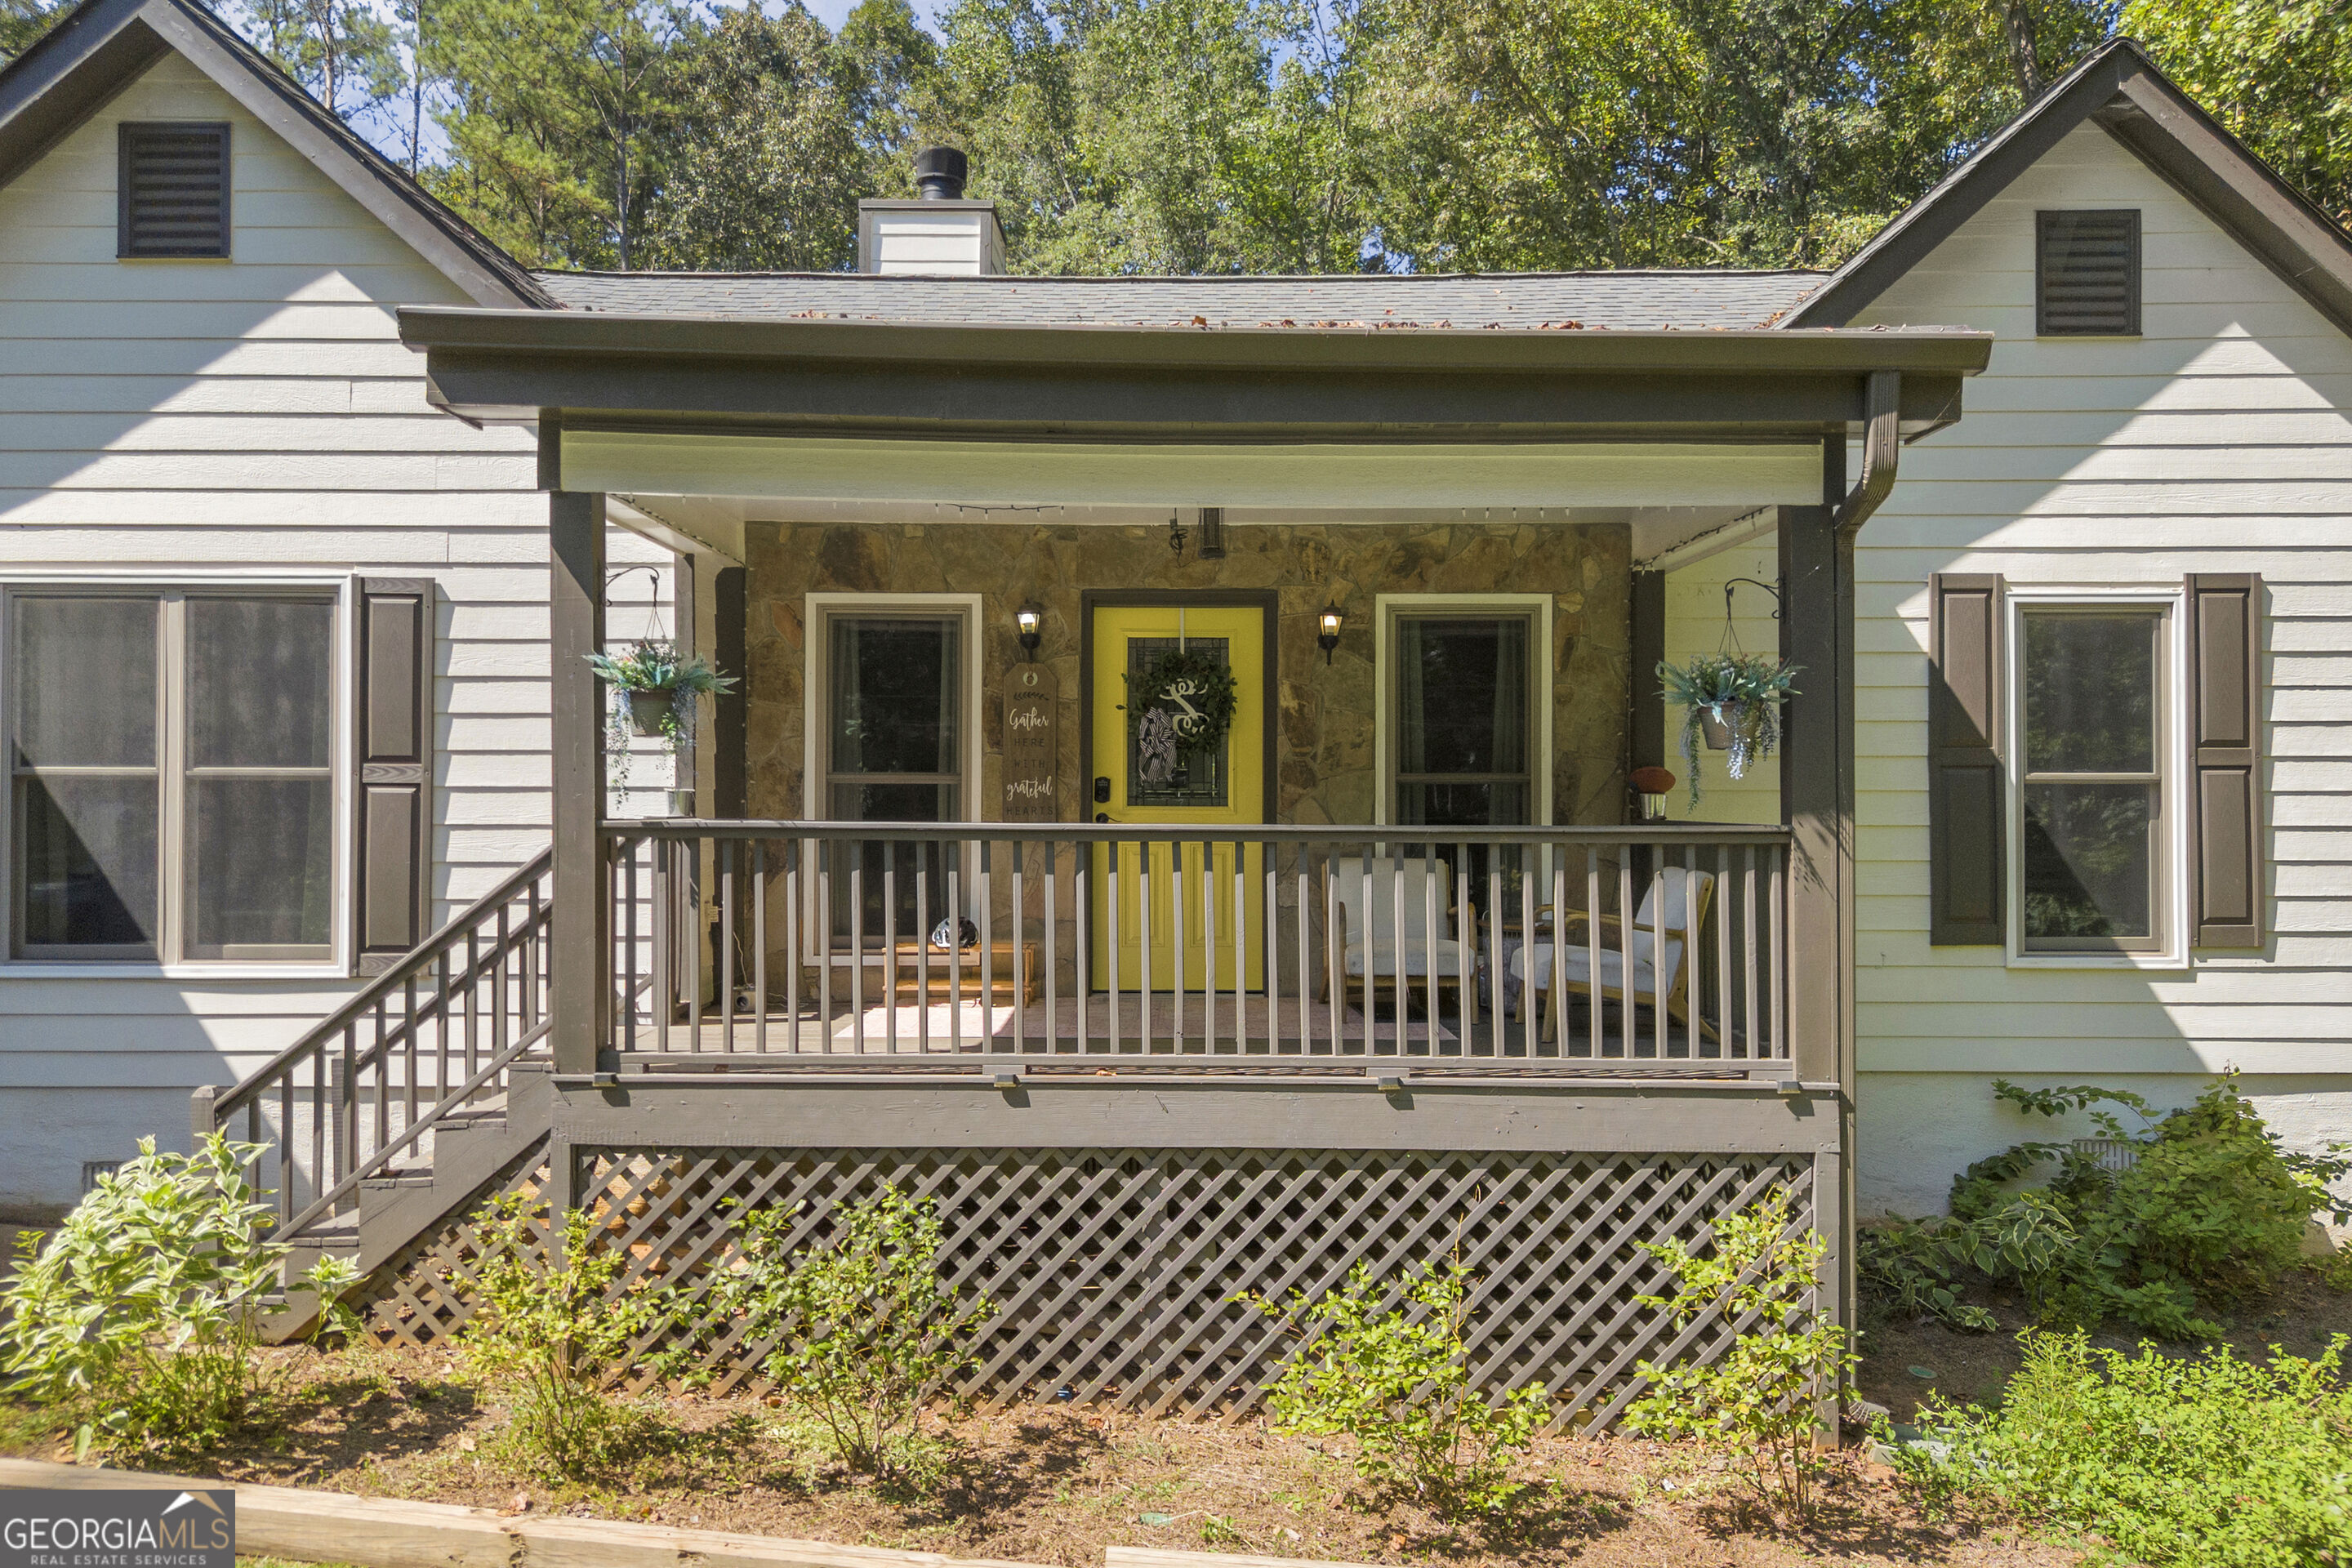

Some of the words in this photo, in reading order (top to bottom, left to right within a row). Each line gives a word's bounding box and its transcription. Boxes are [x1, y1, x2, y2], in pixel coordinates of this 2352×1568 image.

[1009, 706, 1048, 730] Gather
[1013, 738, 1045, 747] HERE
[1013, 760, 1045, 768] WITH
[1007, 776, 1053, 800] grateful
[1006, 806, 1054, 816] HEARTS
